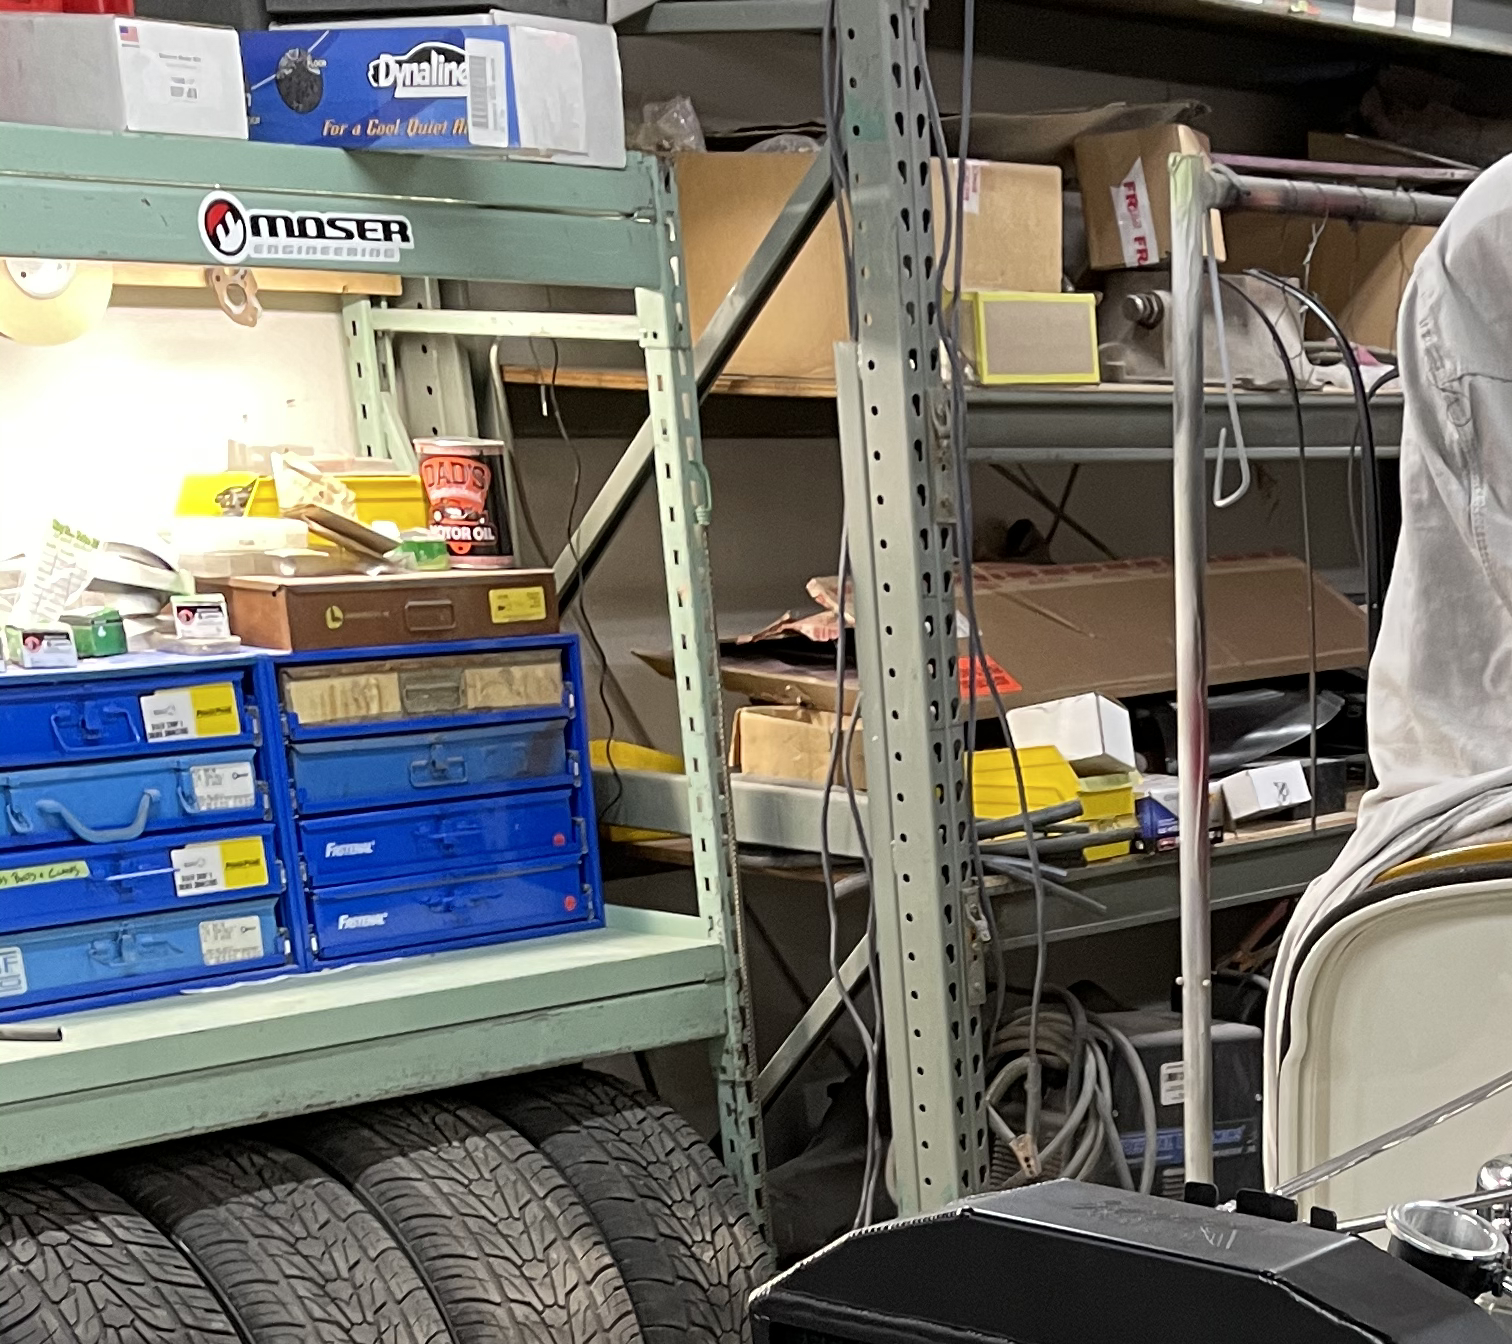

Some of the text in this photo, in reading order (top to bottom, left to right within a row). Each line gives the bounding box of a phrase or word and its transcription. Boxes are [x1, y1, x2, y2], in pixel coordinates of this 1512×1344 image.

[322, 118, 348, 137] For
[352, 123, 361, 136] a
[406, 117, 448, 138] Quiet
[249, 214, 411, 243] MOSER
[253, 244, 396, 259] ENGINEERING
[424, 461, 486, 490] DAD'S
[472, 527, 496, 541] OIL
